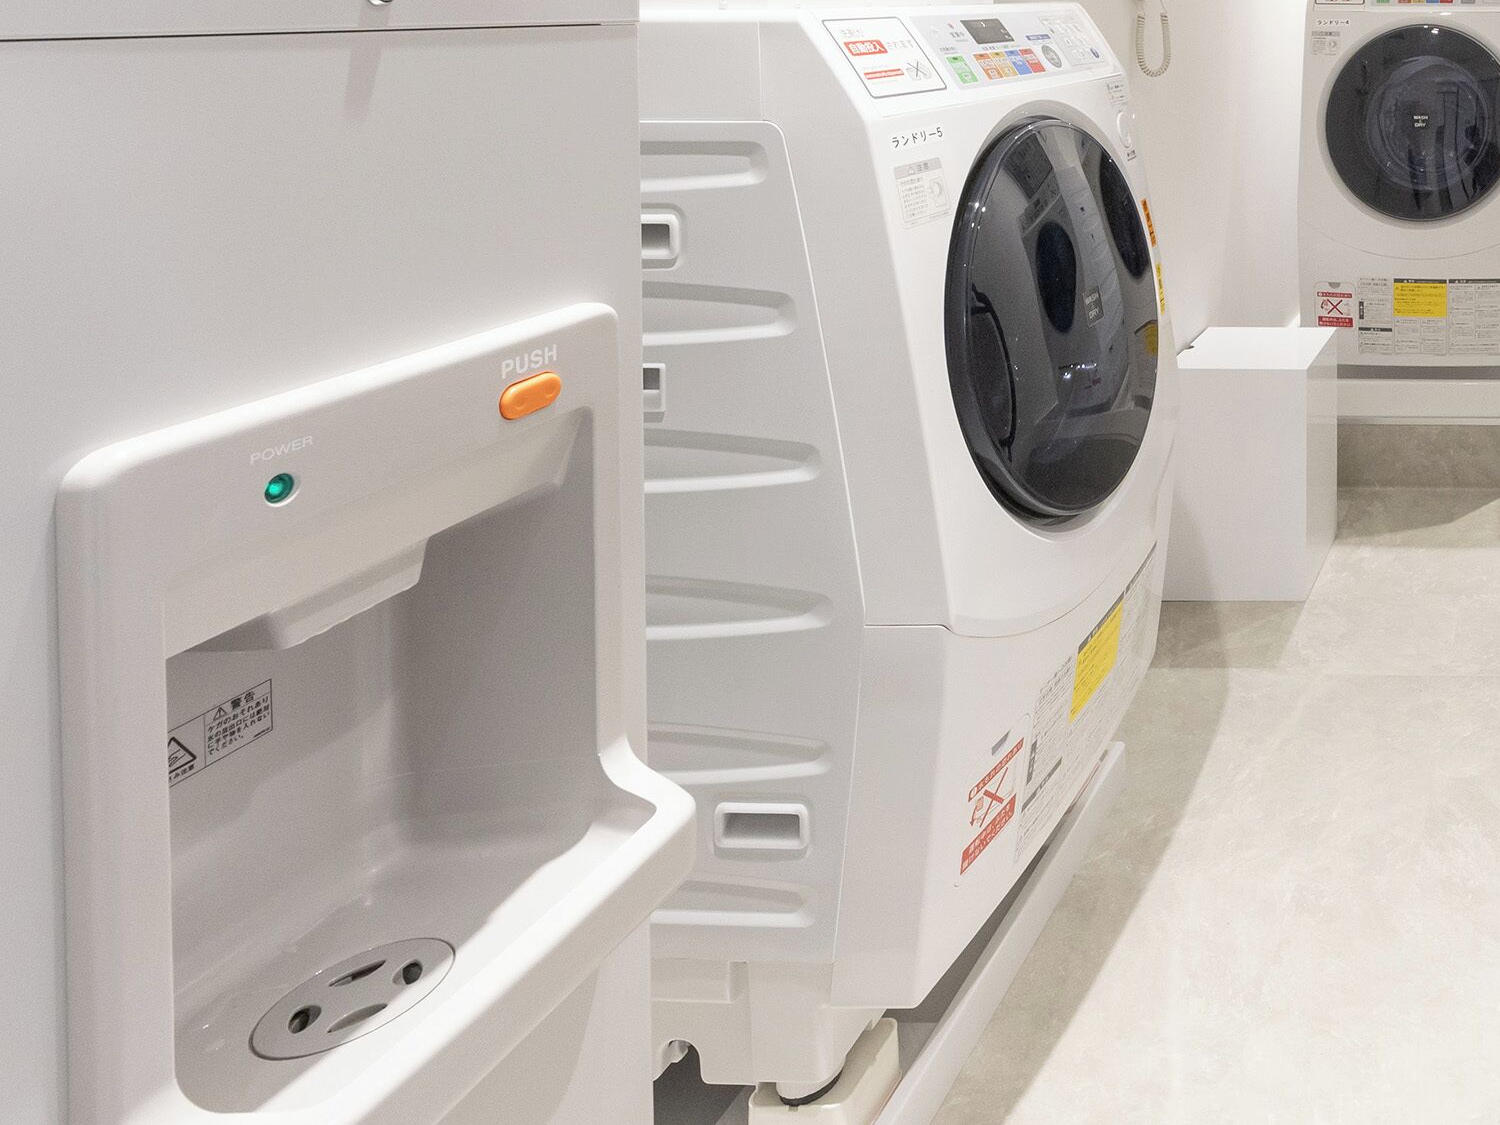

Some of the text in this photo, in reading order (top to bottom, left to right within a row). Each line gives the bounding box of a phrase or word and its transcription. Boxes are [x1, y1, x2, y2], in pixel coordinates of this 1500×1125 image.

[892, 127, 943, 149] ランドリー5
[501, 345, 558, 378] PUSH
[249, 434, 315, 466] POWER
[207, 695, 269, 733] ケガのおそれあり
[231, 691, 255, 711] 警告
[207, 734, 244, 756] でください。
